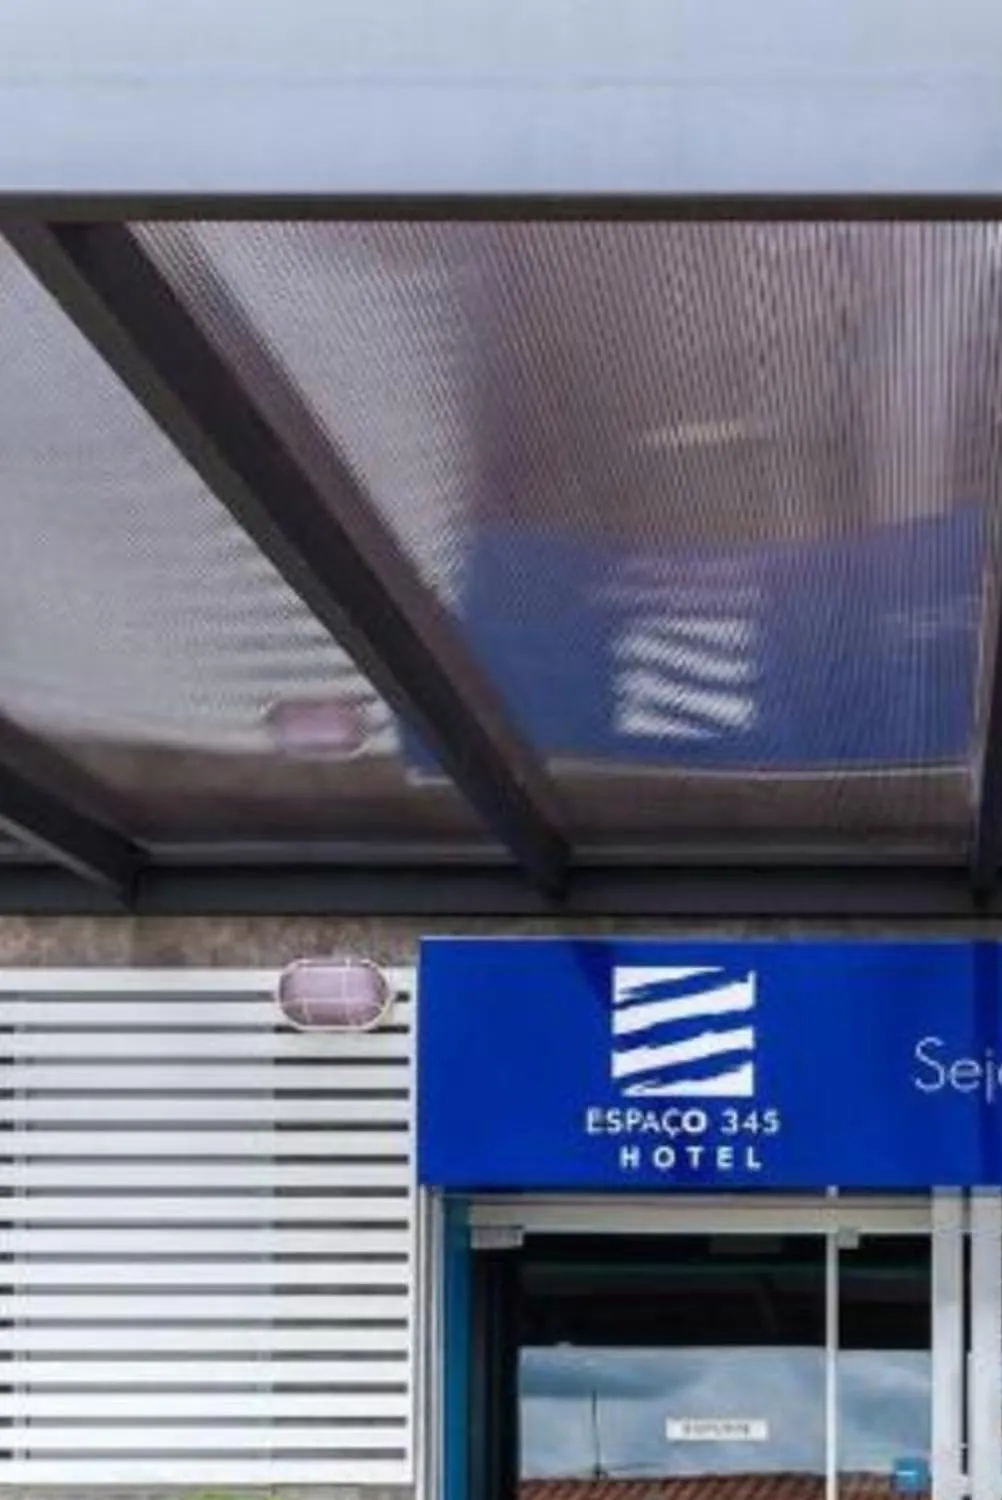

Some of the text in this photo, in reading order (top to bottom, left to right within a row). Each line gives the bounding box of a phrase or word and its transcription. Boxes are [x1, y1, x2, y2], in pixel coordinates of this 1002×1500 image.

[587, 1106, 781, 1138] ESPAÇO 345
[619, 1146, 762, 1171] HOTEL
